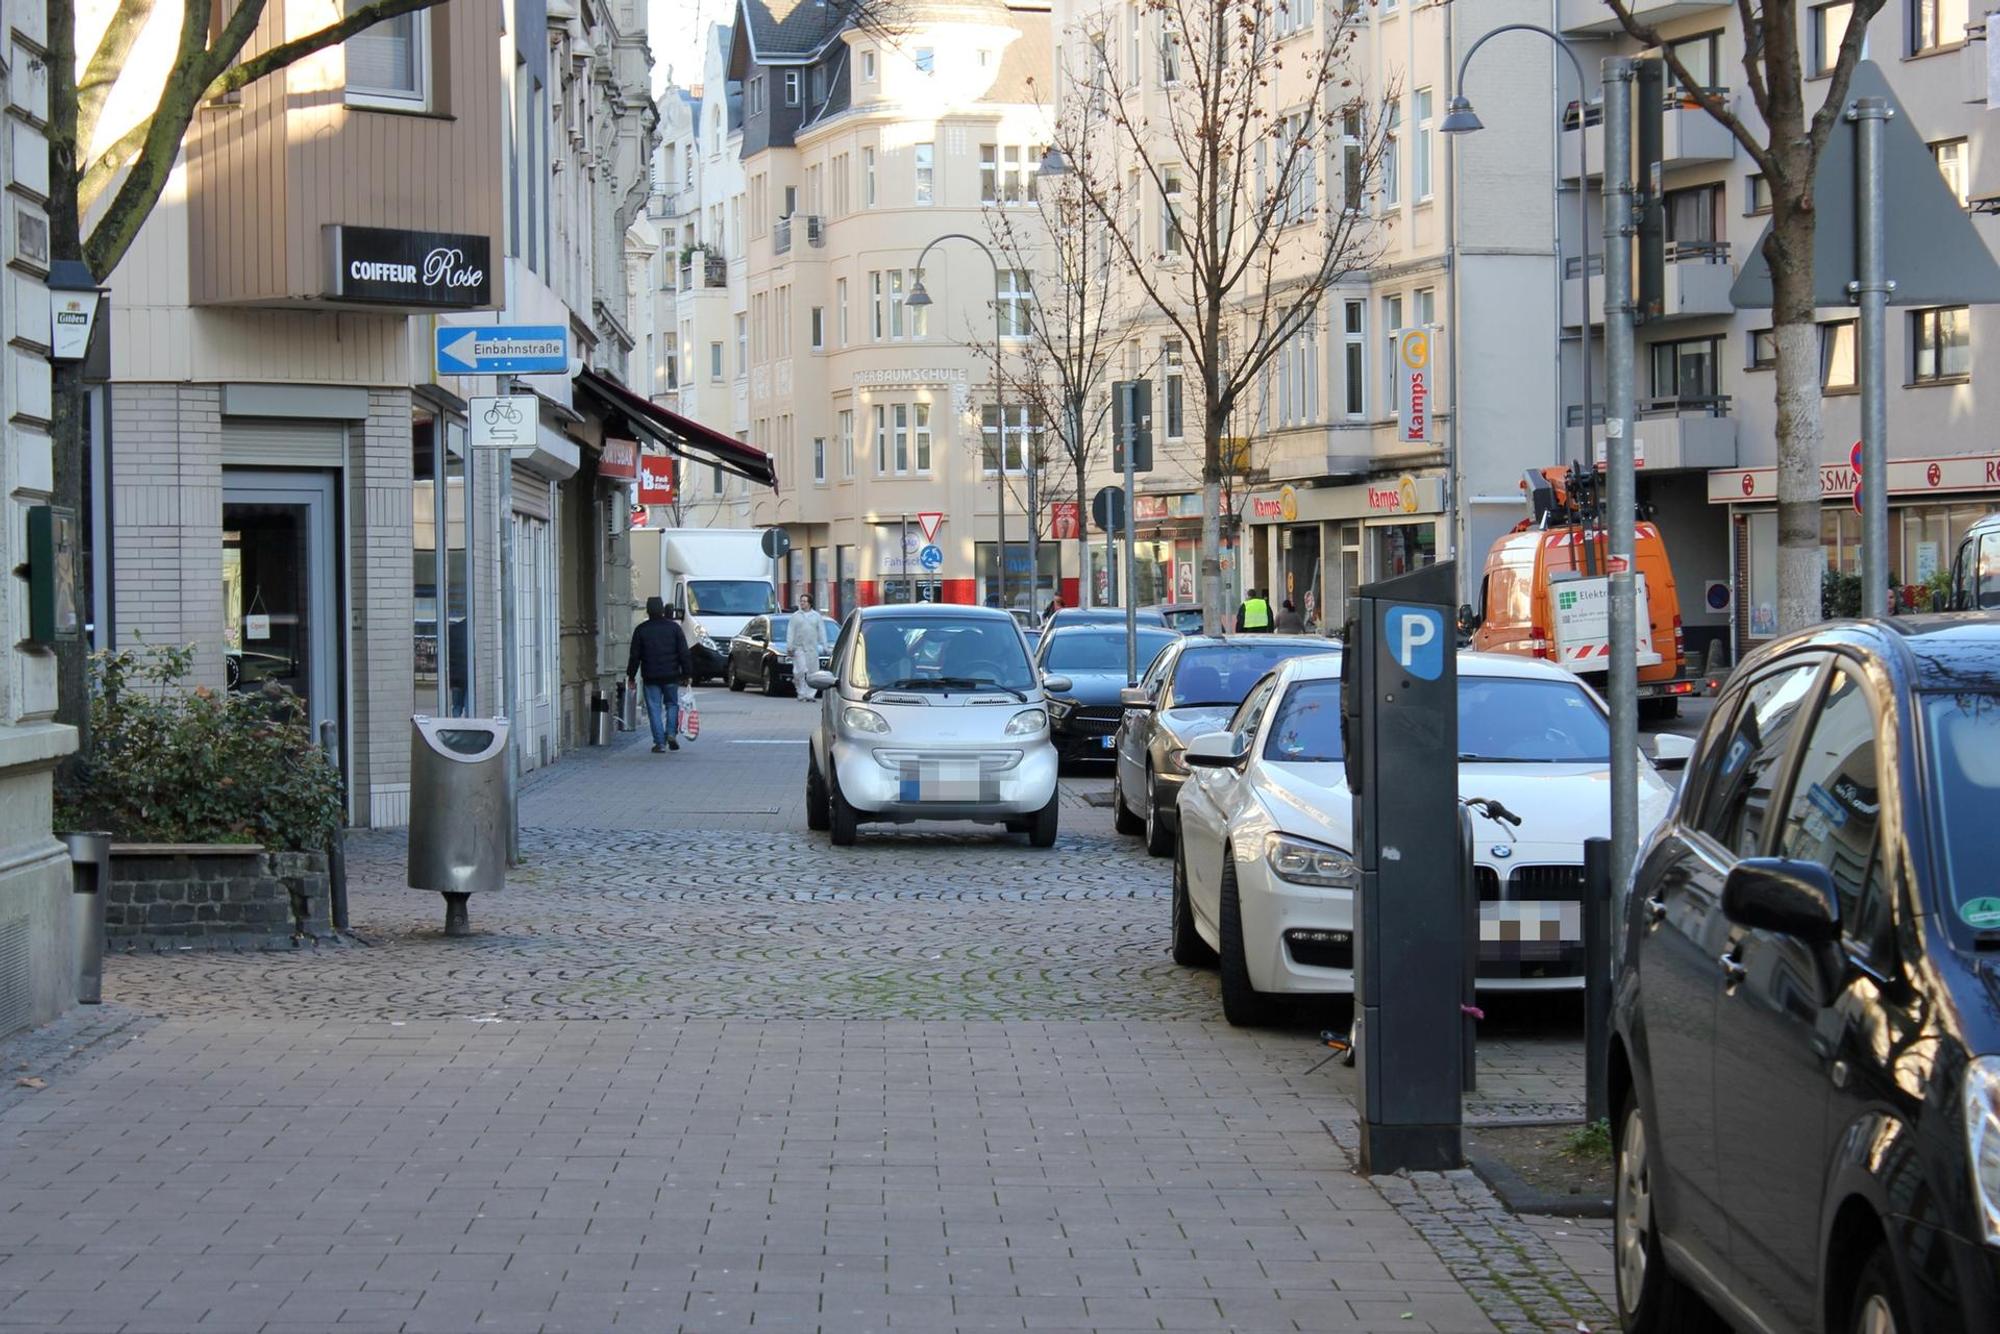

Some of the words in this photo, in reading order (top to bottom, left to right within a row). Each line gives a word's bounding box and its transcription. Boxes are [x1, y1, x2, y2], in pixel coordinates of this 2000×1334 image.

[351, 260, 417, 284] COIFFEUR
[423, 248, 483, 287] Rose
[474, 343, 560, 355] Einbahnstraße
[1408, 373, 1428, 439] Kamps
[1820, 468, 1859, 491] SSMA
[1253, 497, 1281, 520] Kamps
[1368, 487, 1400, 512] Kamps
[1402, 614, 1435, 666] P
